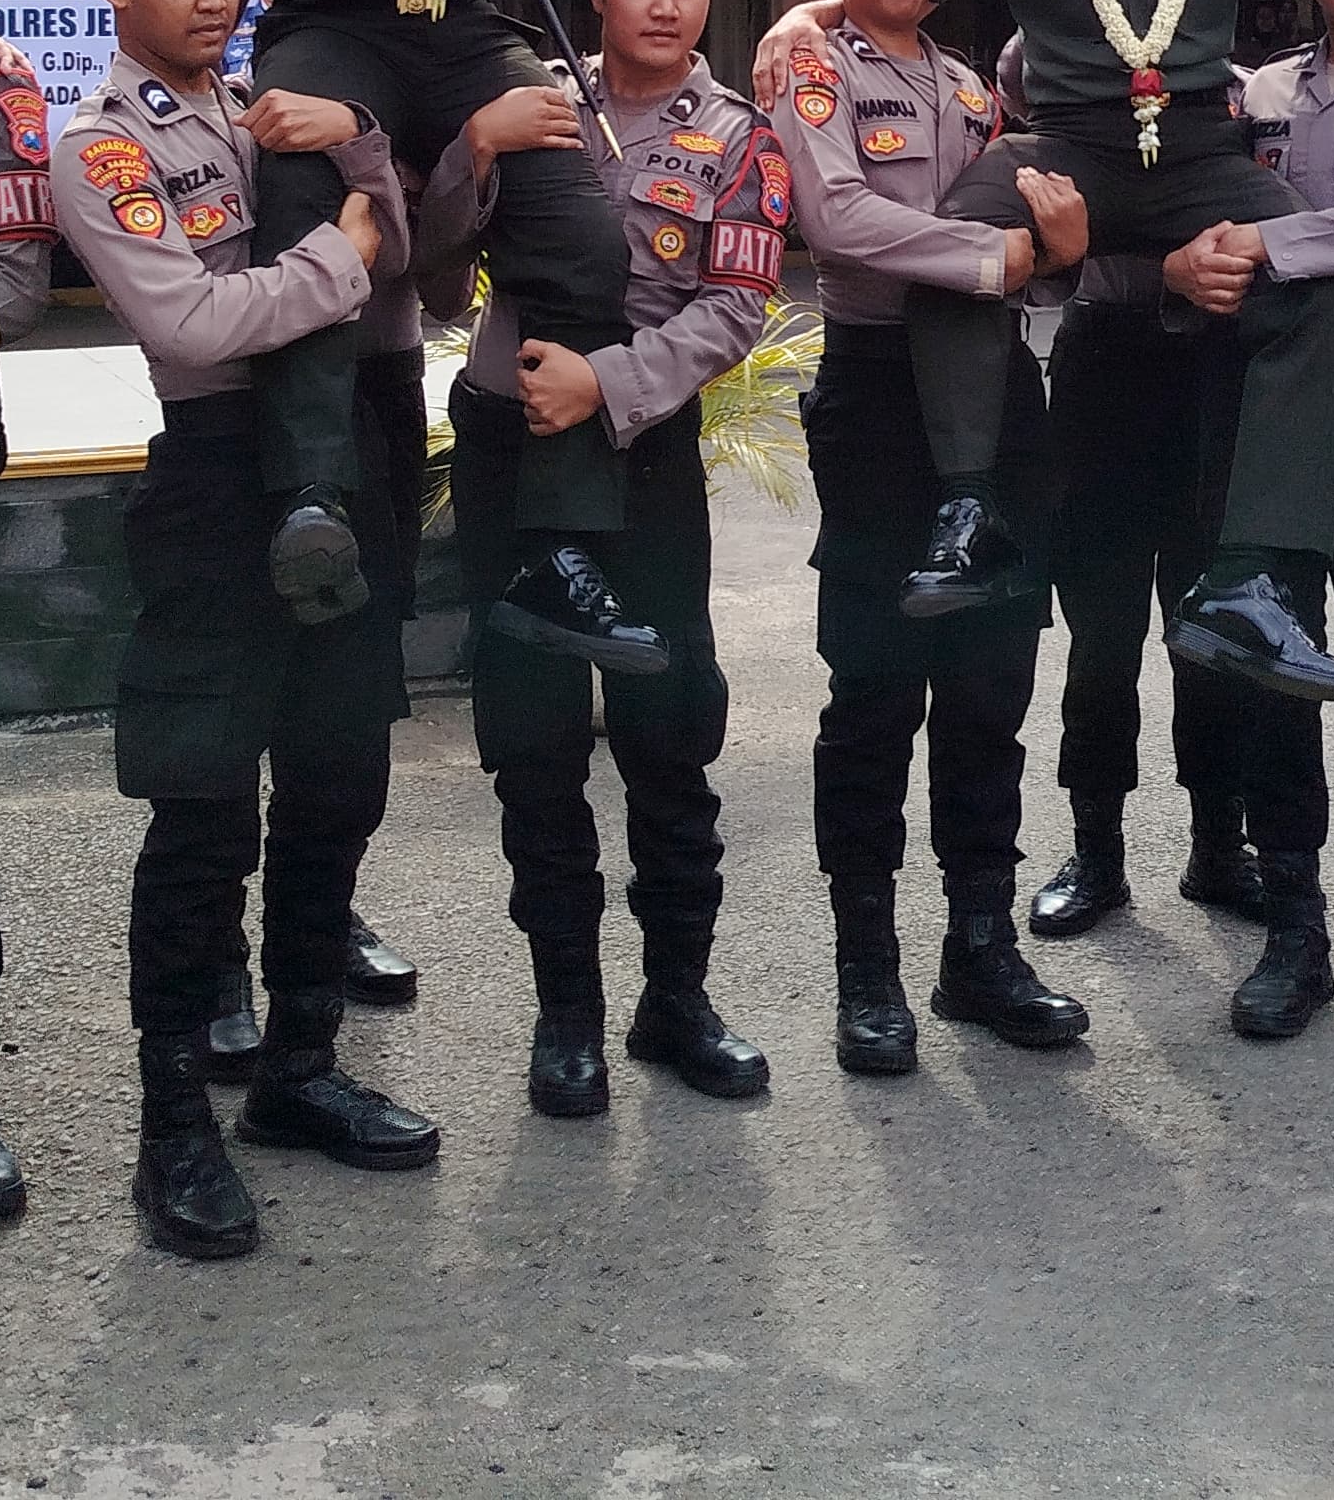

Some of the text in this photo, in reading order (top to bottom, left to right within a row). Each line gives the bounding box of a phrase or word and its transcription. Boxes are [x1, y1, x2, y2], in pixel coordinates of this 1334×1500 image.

[84, 8, 119, 38] JE
[42, 51, 104, 76] G.Dip.,
[119, 175, 133, 188] 3
[646, 153, 722, 188] POLRI
